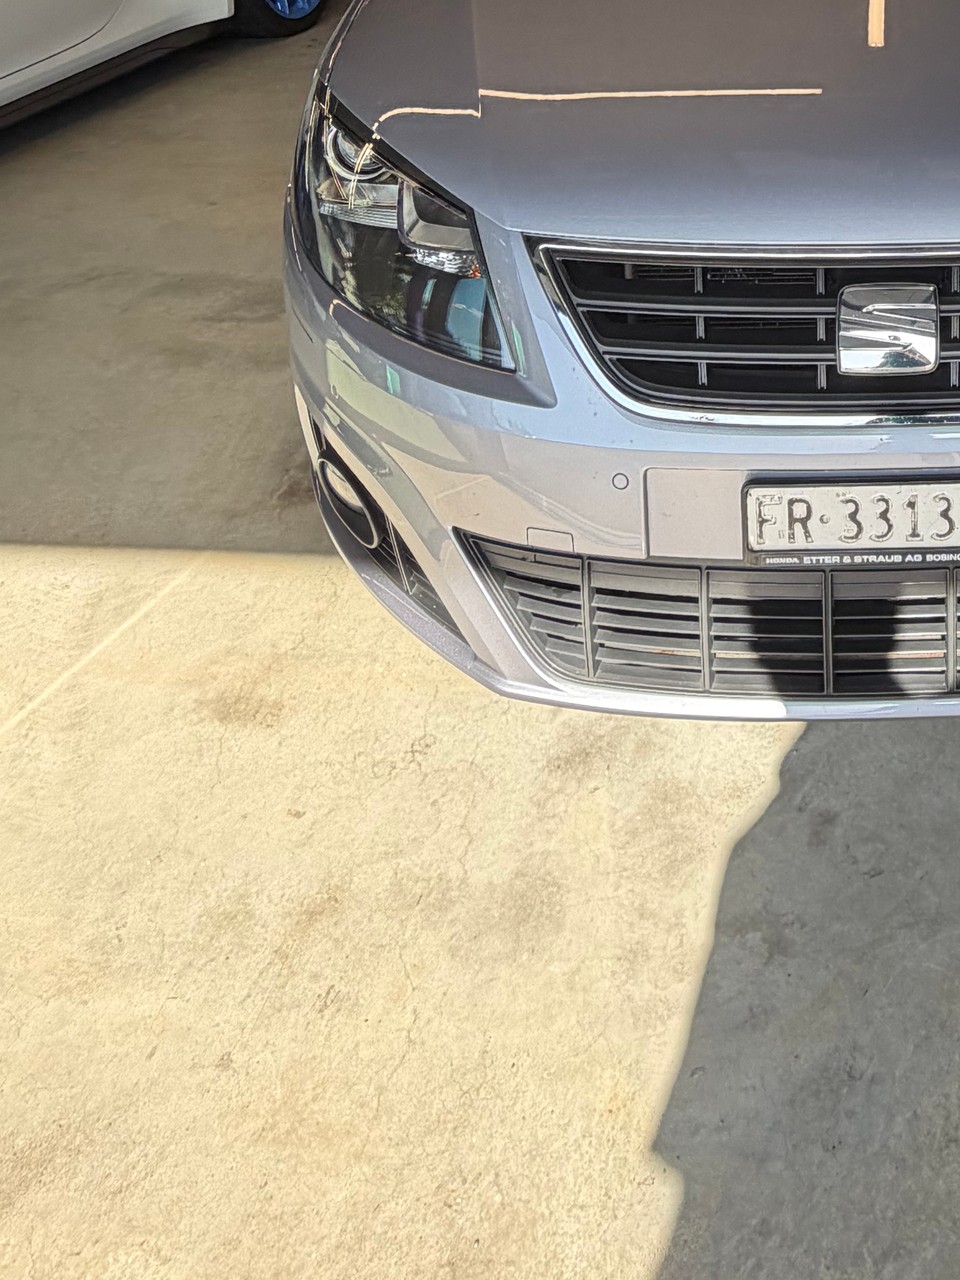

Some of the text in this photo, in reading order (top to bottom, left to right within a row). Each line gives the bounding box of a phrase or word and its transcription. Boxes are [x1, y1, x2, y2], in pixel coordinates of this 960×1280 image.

[803, 556, 840, 564] ETTER
[842, 555, 852, 563] &
[853, 554, 903, 563] STRAUB
[904, 553, 923, 562] AG
